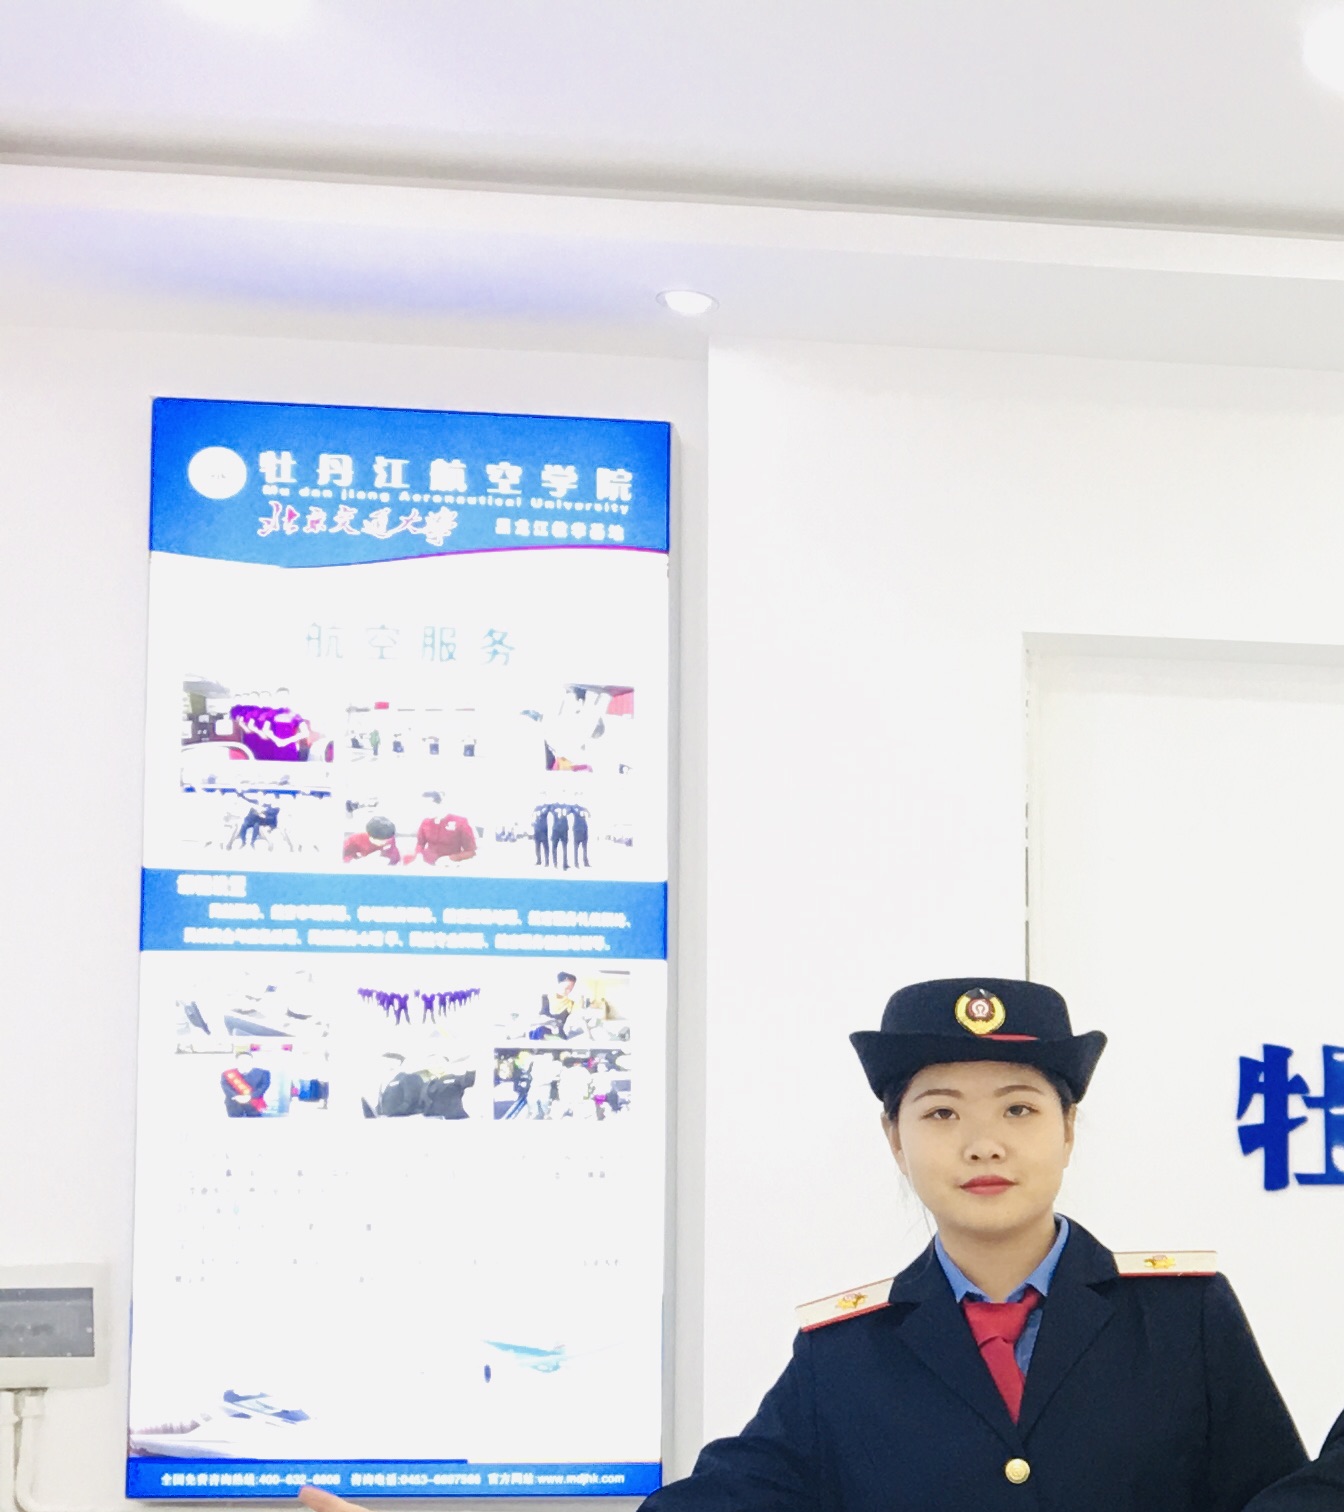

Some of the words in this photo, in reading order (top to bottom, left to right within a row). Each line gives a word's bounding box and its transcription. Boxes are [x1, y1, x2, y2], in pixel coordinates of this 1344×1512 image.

[258, 450, 633, 501] 牡丹江航空学院
[530, 497, 629, 515] University
[304, 621, 516, 667] 航空服务
